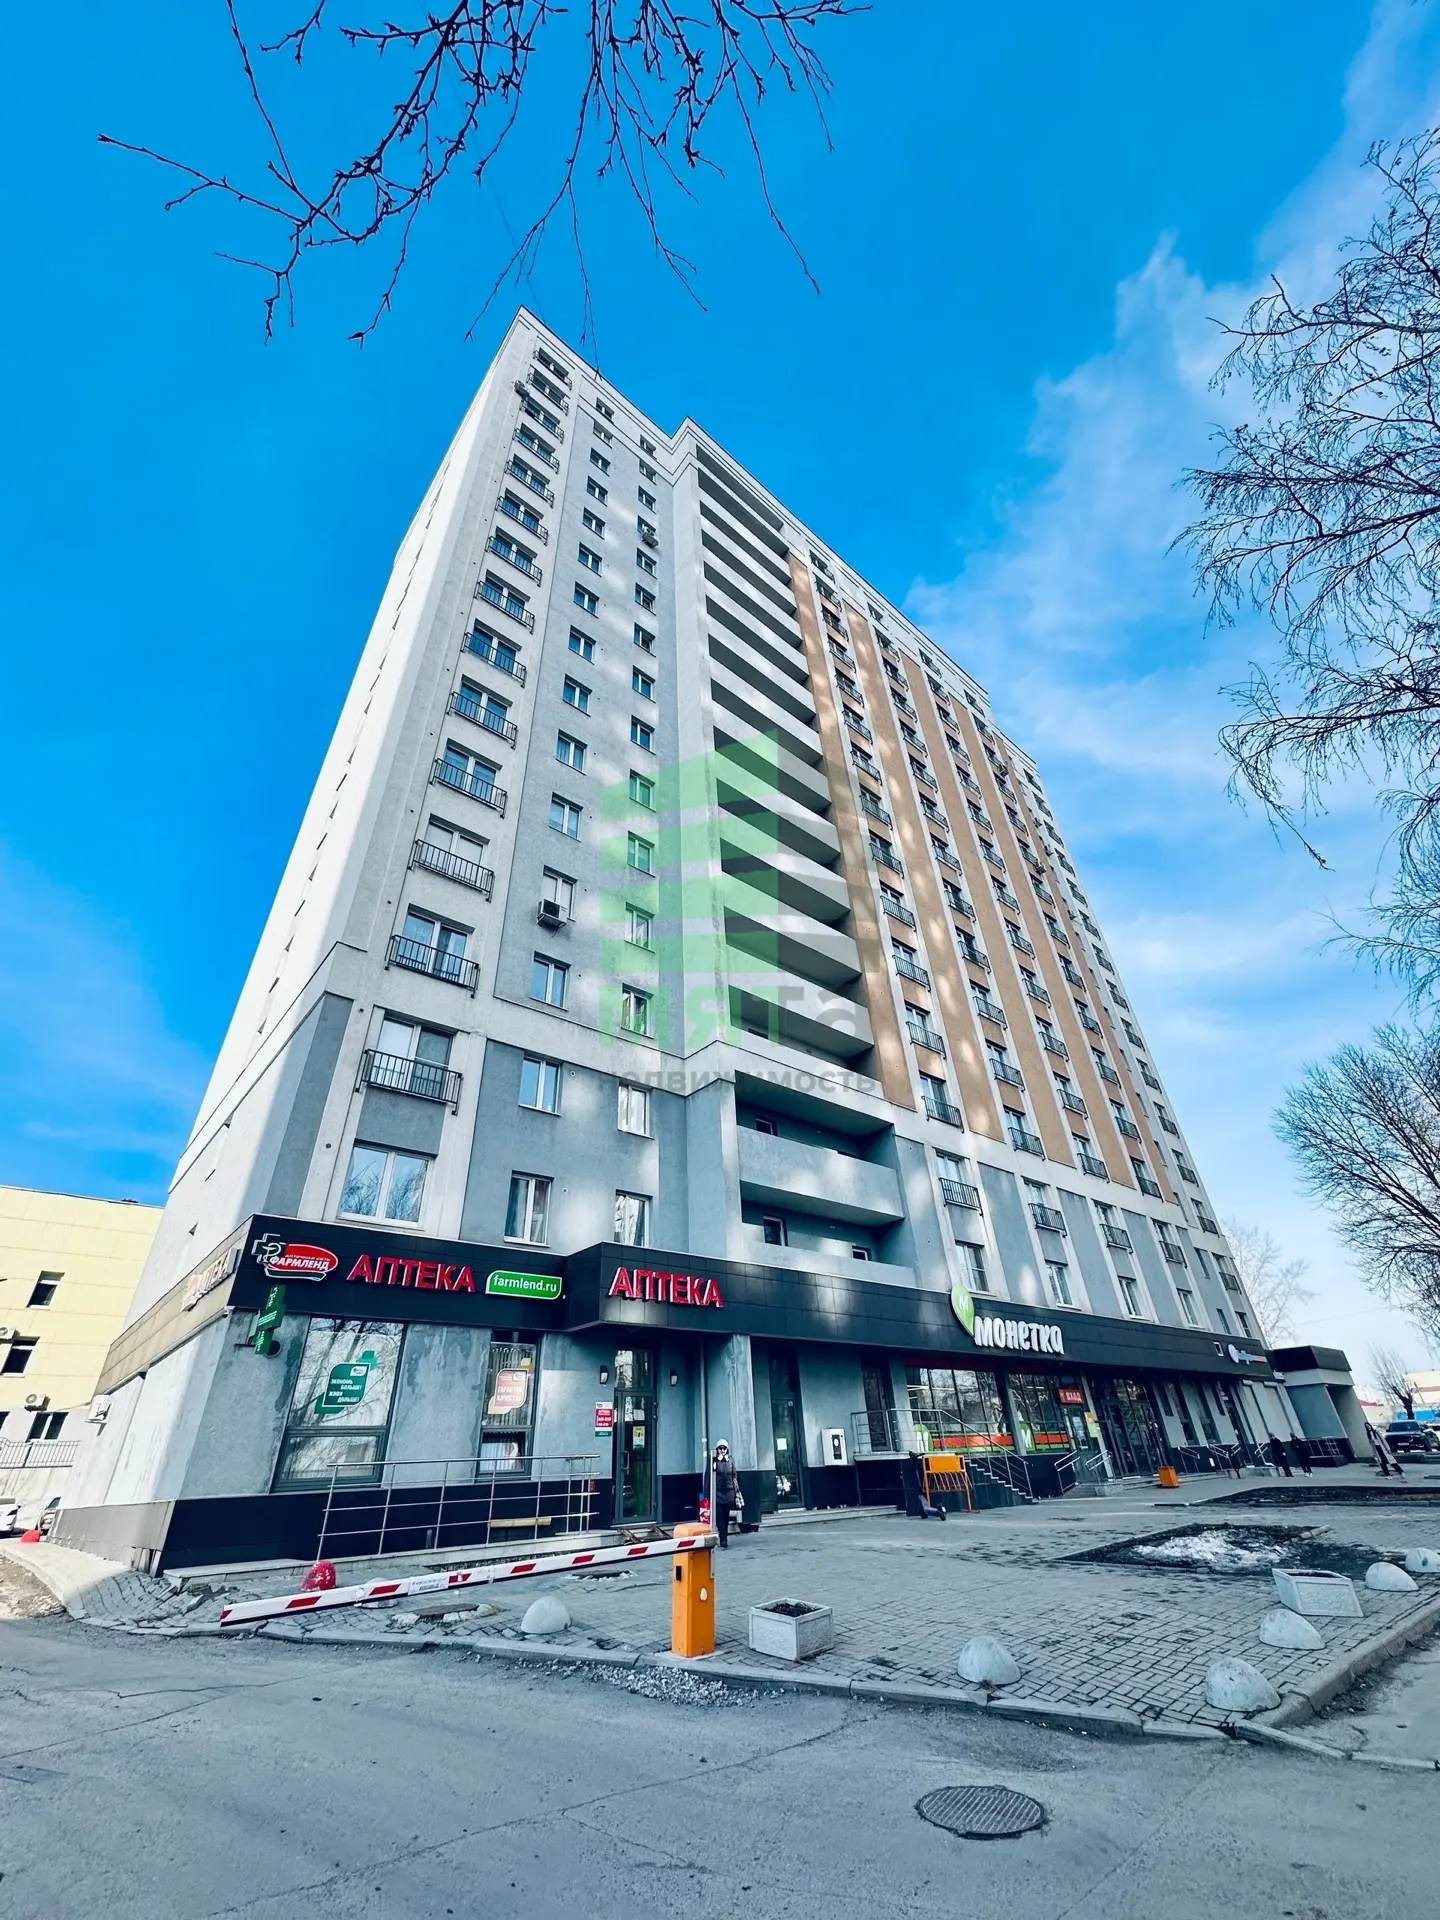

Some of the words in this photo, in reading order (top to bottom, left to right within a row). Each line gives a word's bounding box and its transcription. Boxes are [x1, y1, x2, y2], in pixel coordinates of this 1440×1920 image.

[269, 1255, 330, 1271] ФАРМЛЕНД
[346, 1254, 477, 1293] АПТЕКА
[493, 1274, 557, 1293] farmlend.ru
[608, 1266, 724, 1308] АПТЕКА
[1066, 1391, 1082, 1403] ВХОД
